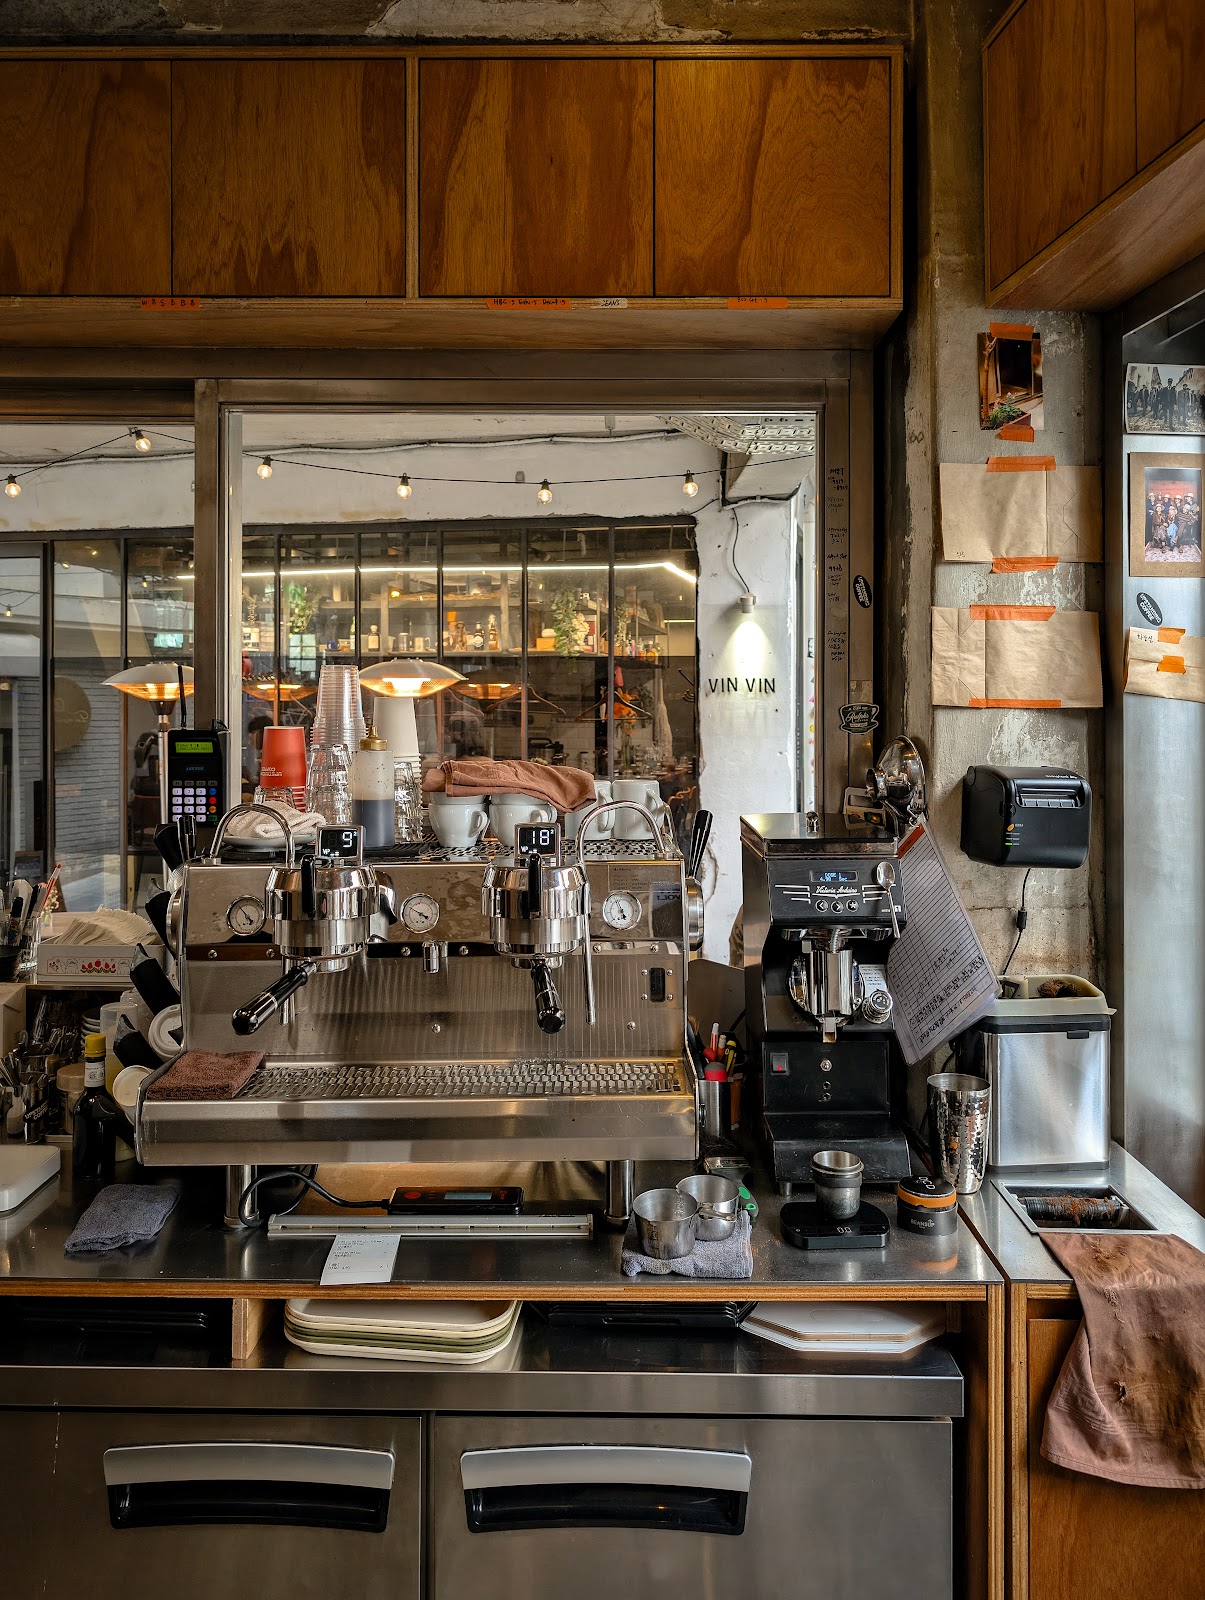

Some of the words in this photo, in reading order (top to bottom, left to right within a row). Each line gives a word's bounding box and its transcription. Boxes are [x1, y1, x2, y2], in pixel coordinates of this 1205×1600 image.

[708, 677, 738, 693] VIN
[745, 677, 776, 694] VIN
[342, 831, 353, 847] 9
[532, 829, 550, 846] 18
